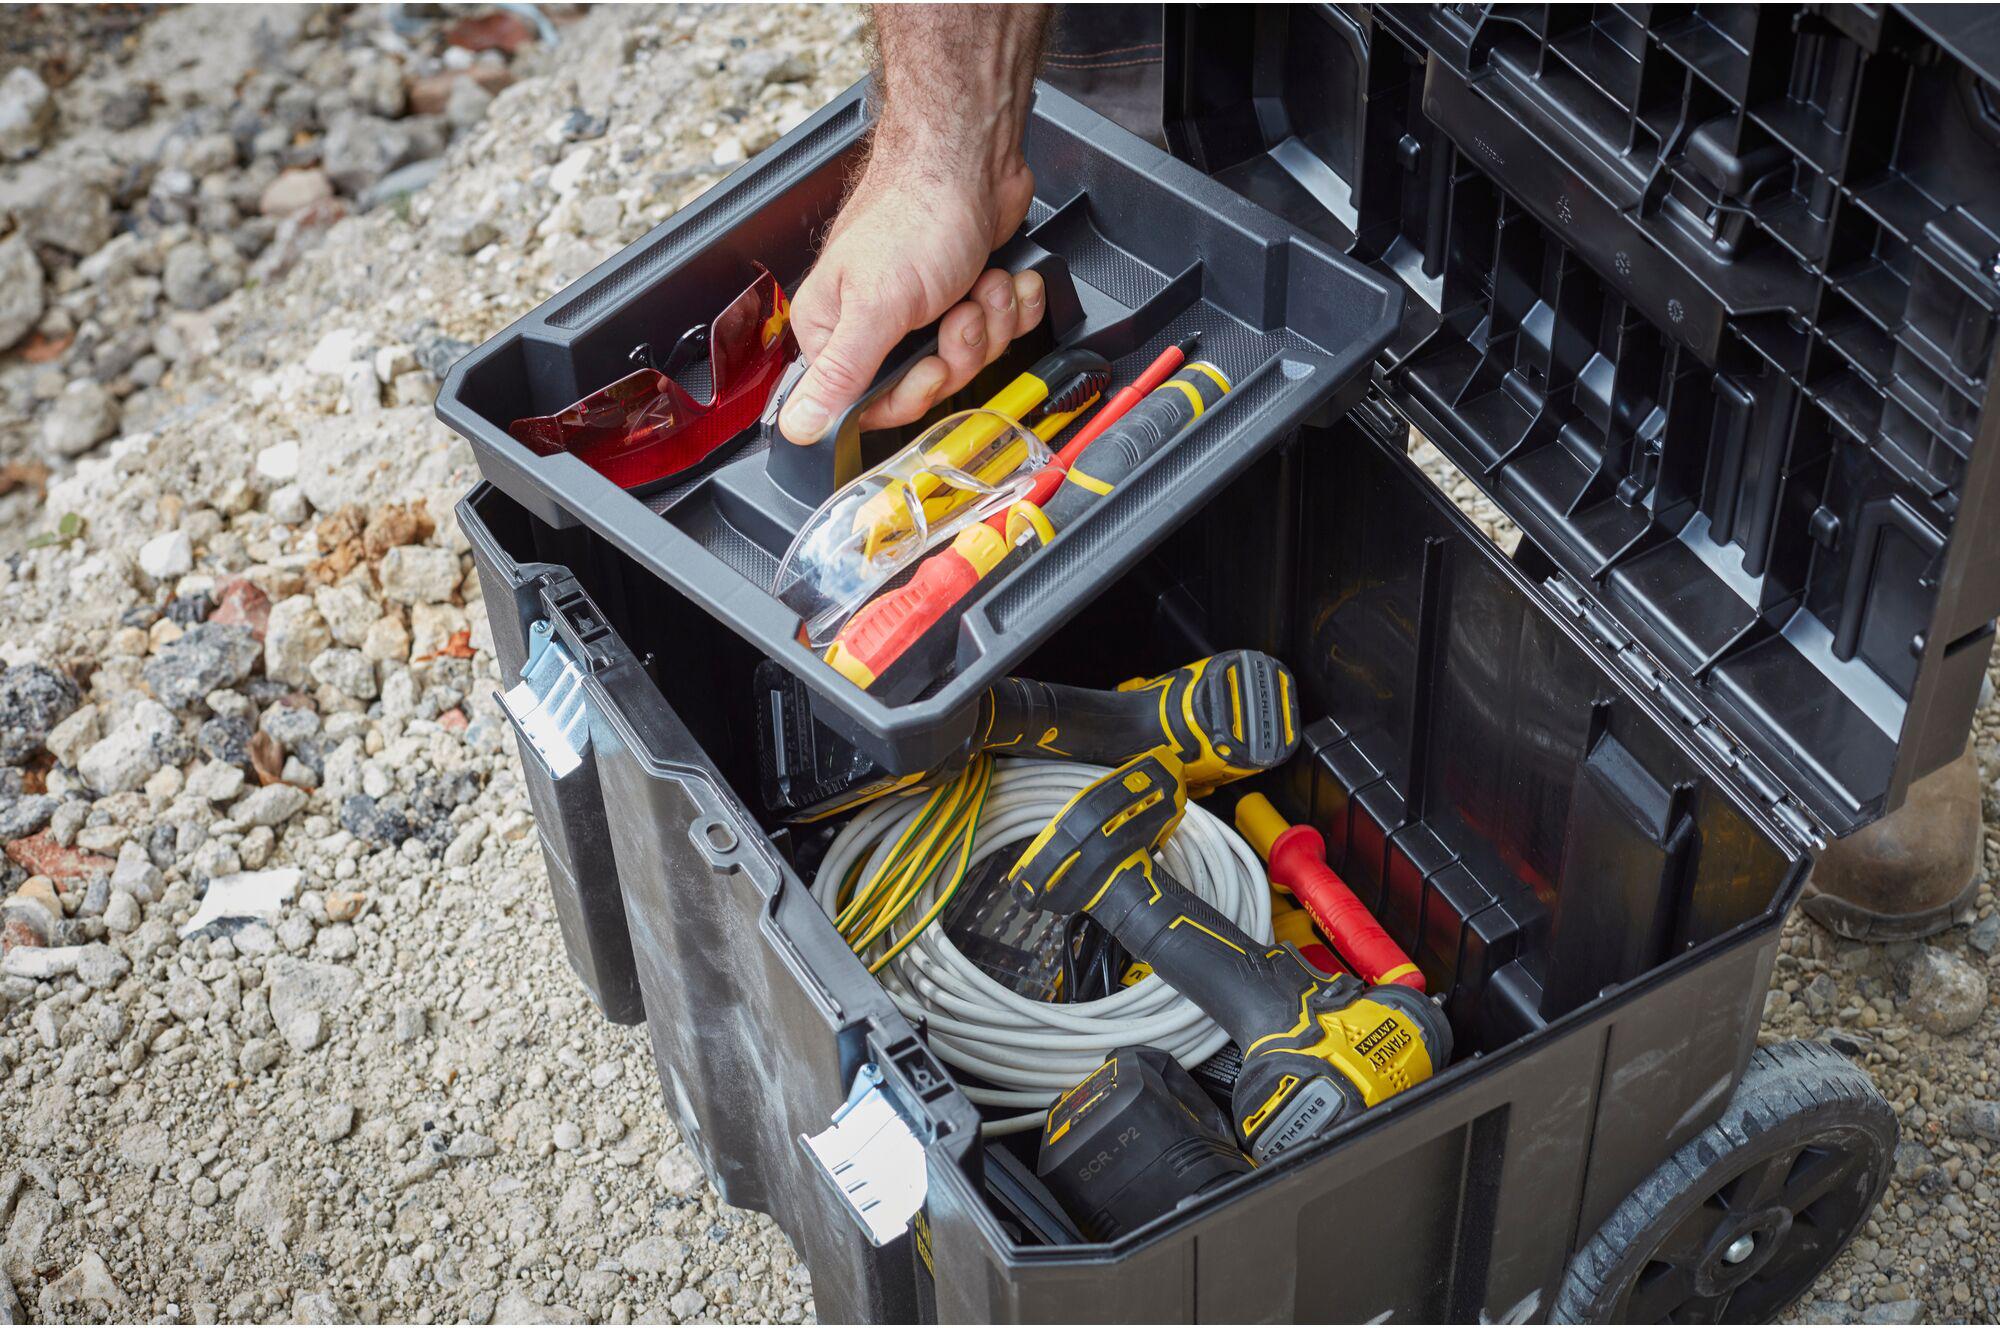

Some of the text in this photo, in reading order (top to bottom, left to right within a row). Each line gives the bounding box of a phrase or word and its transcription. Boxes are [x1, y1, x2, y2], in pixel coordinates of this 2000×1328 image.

[1257, 660, 1271, 749] BRUSHLESS
[1304, 900, 1336, 942] STANLEY
[1357, 1019, 1396, 1053] FATMAX
[1368, 1028, 1411, 1072] STANLEY
[1079, 1151, 1113, 1181] SCR
[1118, 1126, 1141, 1148] P2
[1262, 1097, 1326, 1161] BRUSHLESS
